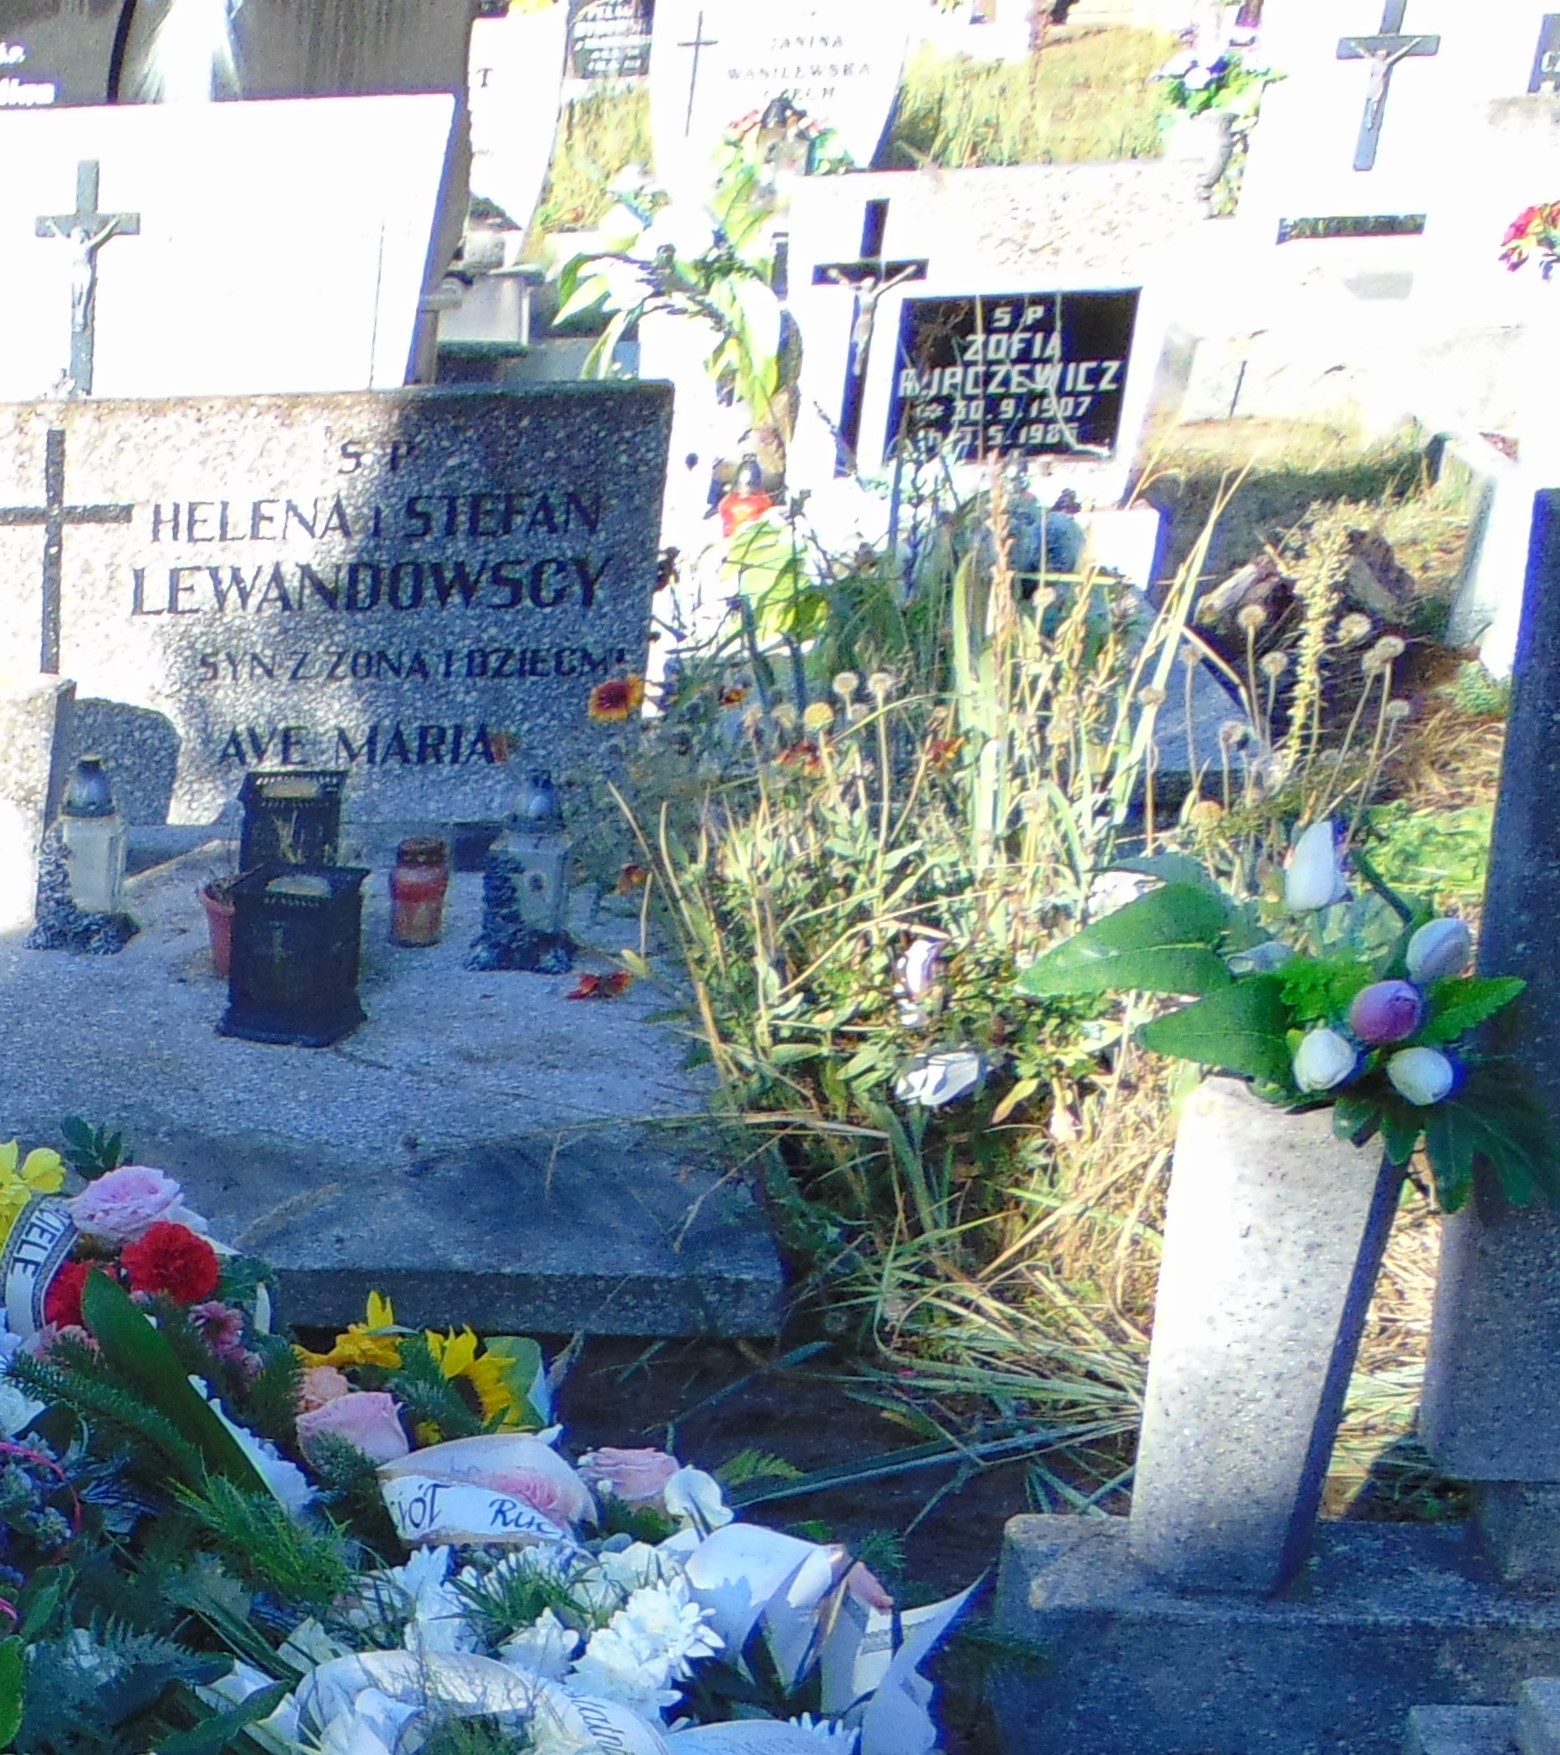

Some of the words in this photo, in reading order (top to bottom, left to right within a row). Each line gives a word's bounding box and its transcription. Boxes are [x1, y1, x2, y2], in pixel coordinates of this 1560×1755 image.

[963, 331, 1063, 362] ZOFIA
[151, 493, 352, 543] HELENA
[402, 493, 603, 538] STEFAN
[130, 556, 613, 616] LEWANDOWSCY
[198, 651, 276, 681] SYN
[287, 651, 316, 681] Z
[216, 725, 309, 766] AVE
[334, 721, 496, 766] MARIA
